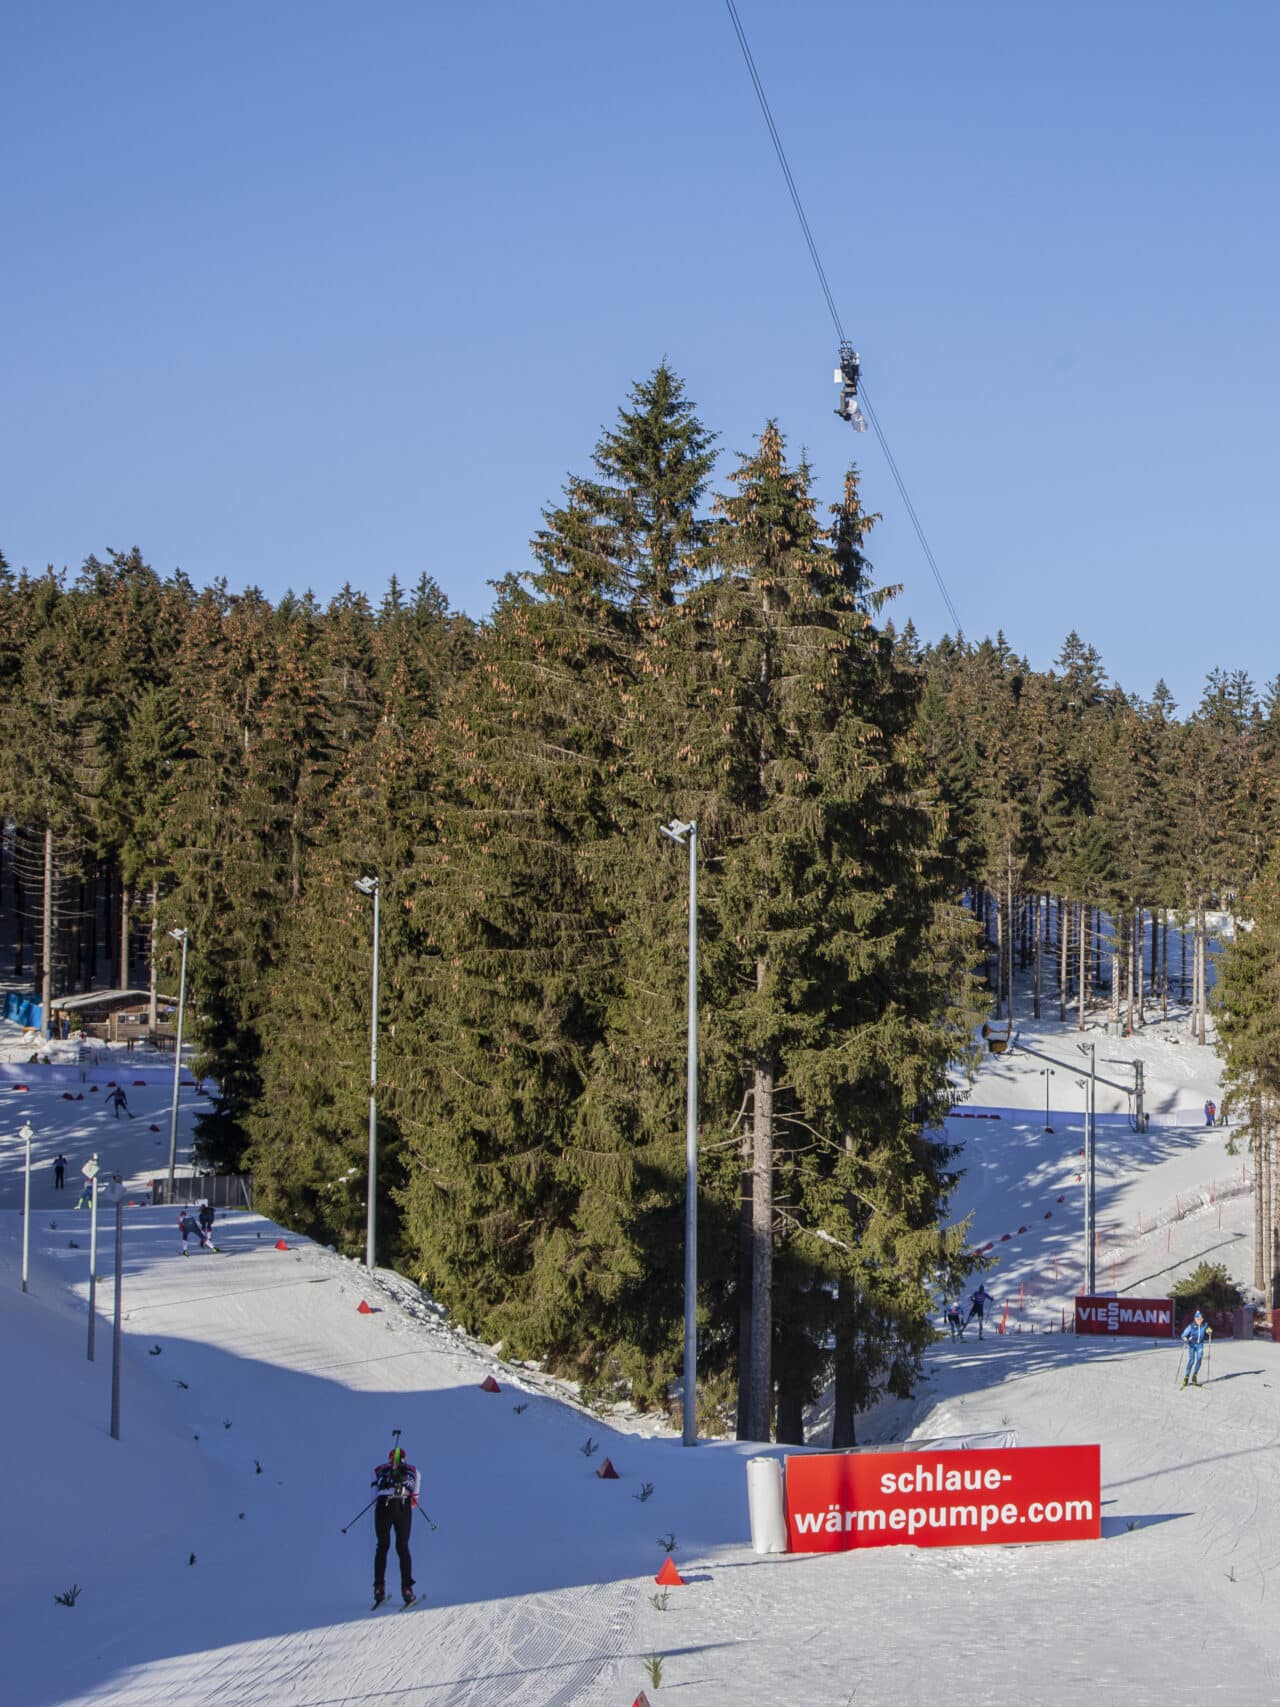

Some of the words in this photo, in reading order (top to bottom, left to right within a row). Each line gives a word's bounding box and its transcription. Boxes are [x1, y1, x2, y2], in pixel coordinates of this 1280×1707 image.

[1078, 1302, 1170, 1330] VIESSMANN
[880, 1464, 1012, 1494] schlaue-
[794, 1499, 1093, 1535] wärmepumpe.com
